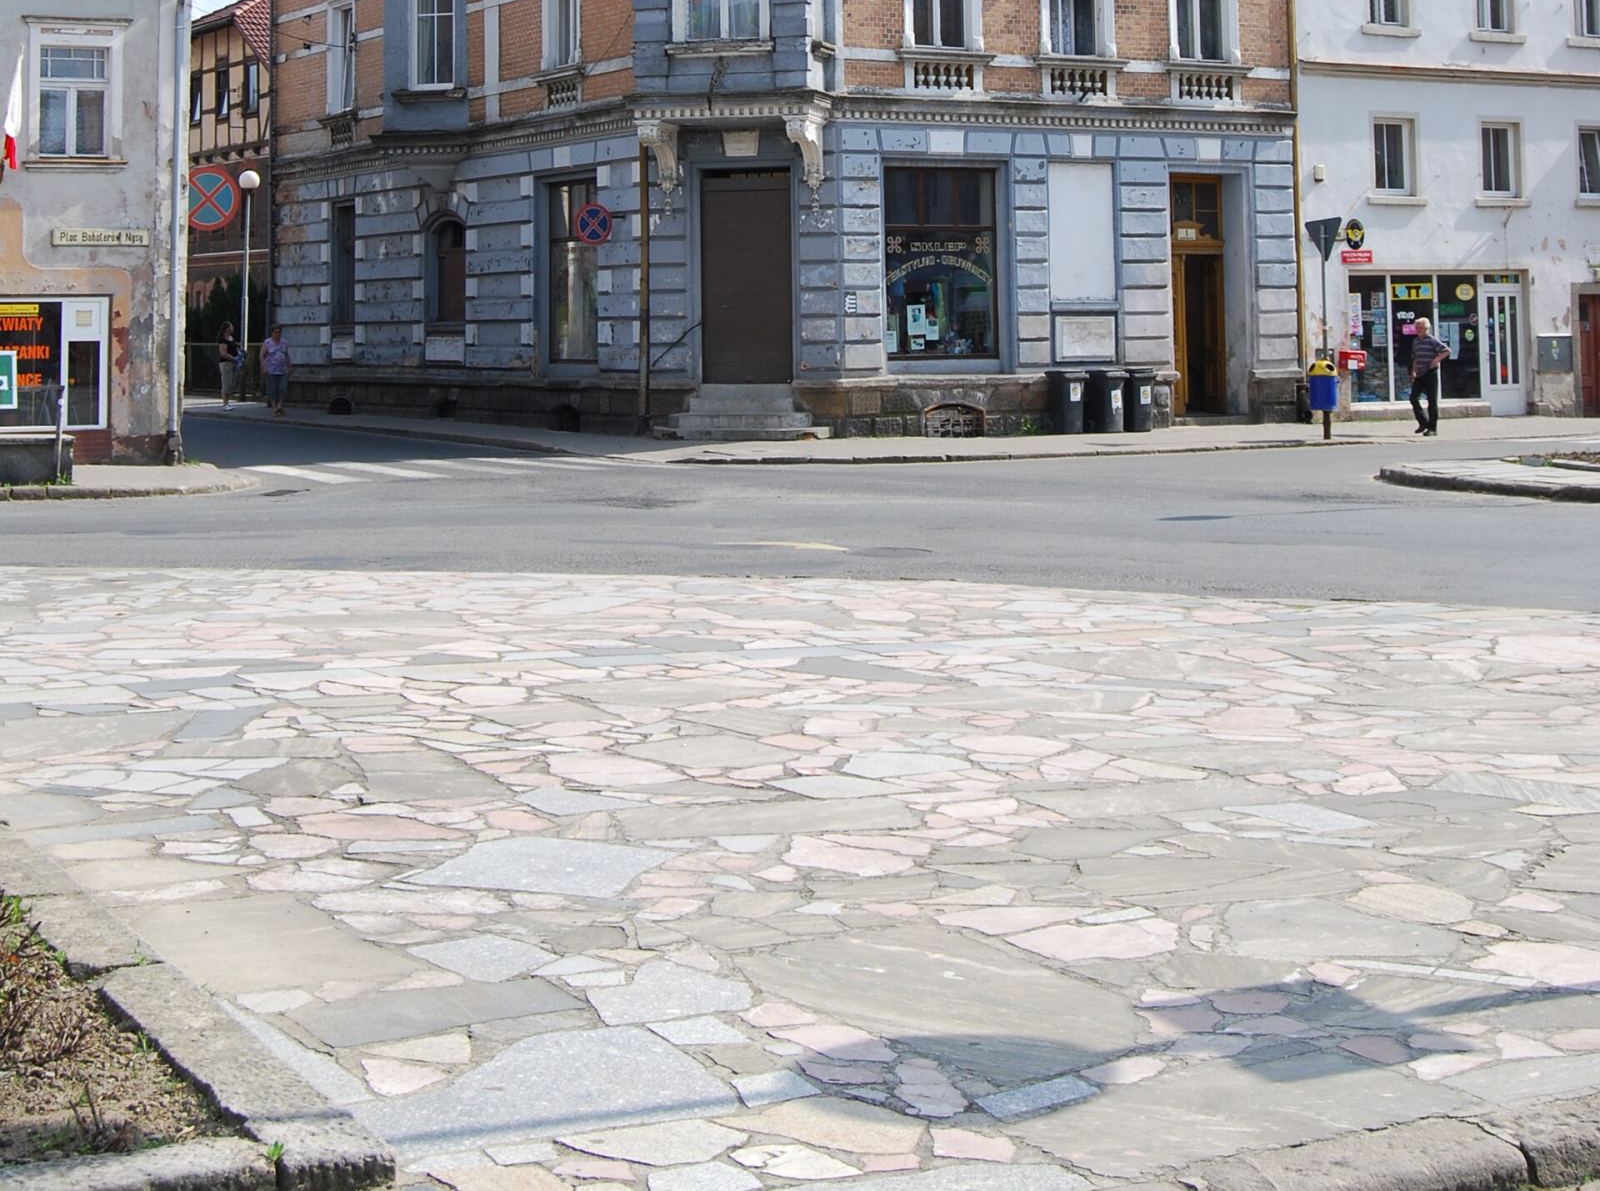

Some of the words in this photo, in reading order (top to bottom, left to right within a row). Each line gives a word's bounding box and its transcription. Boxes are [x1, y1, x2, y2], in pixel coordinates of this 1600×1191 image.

[60, 231, 78, 242] Plac
[125, 231, 144, 244] Nysy
[910, 241, 967, 252] SKLEP
[1392, 284, 1431, 298] LOTTO
[0, 346, 50, 359] ZANKI
